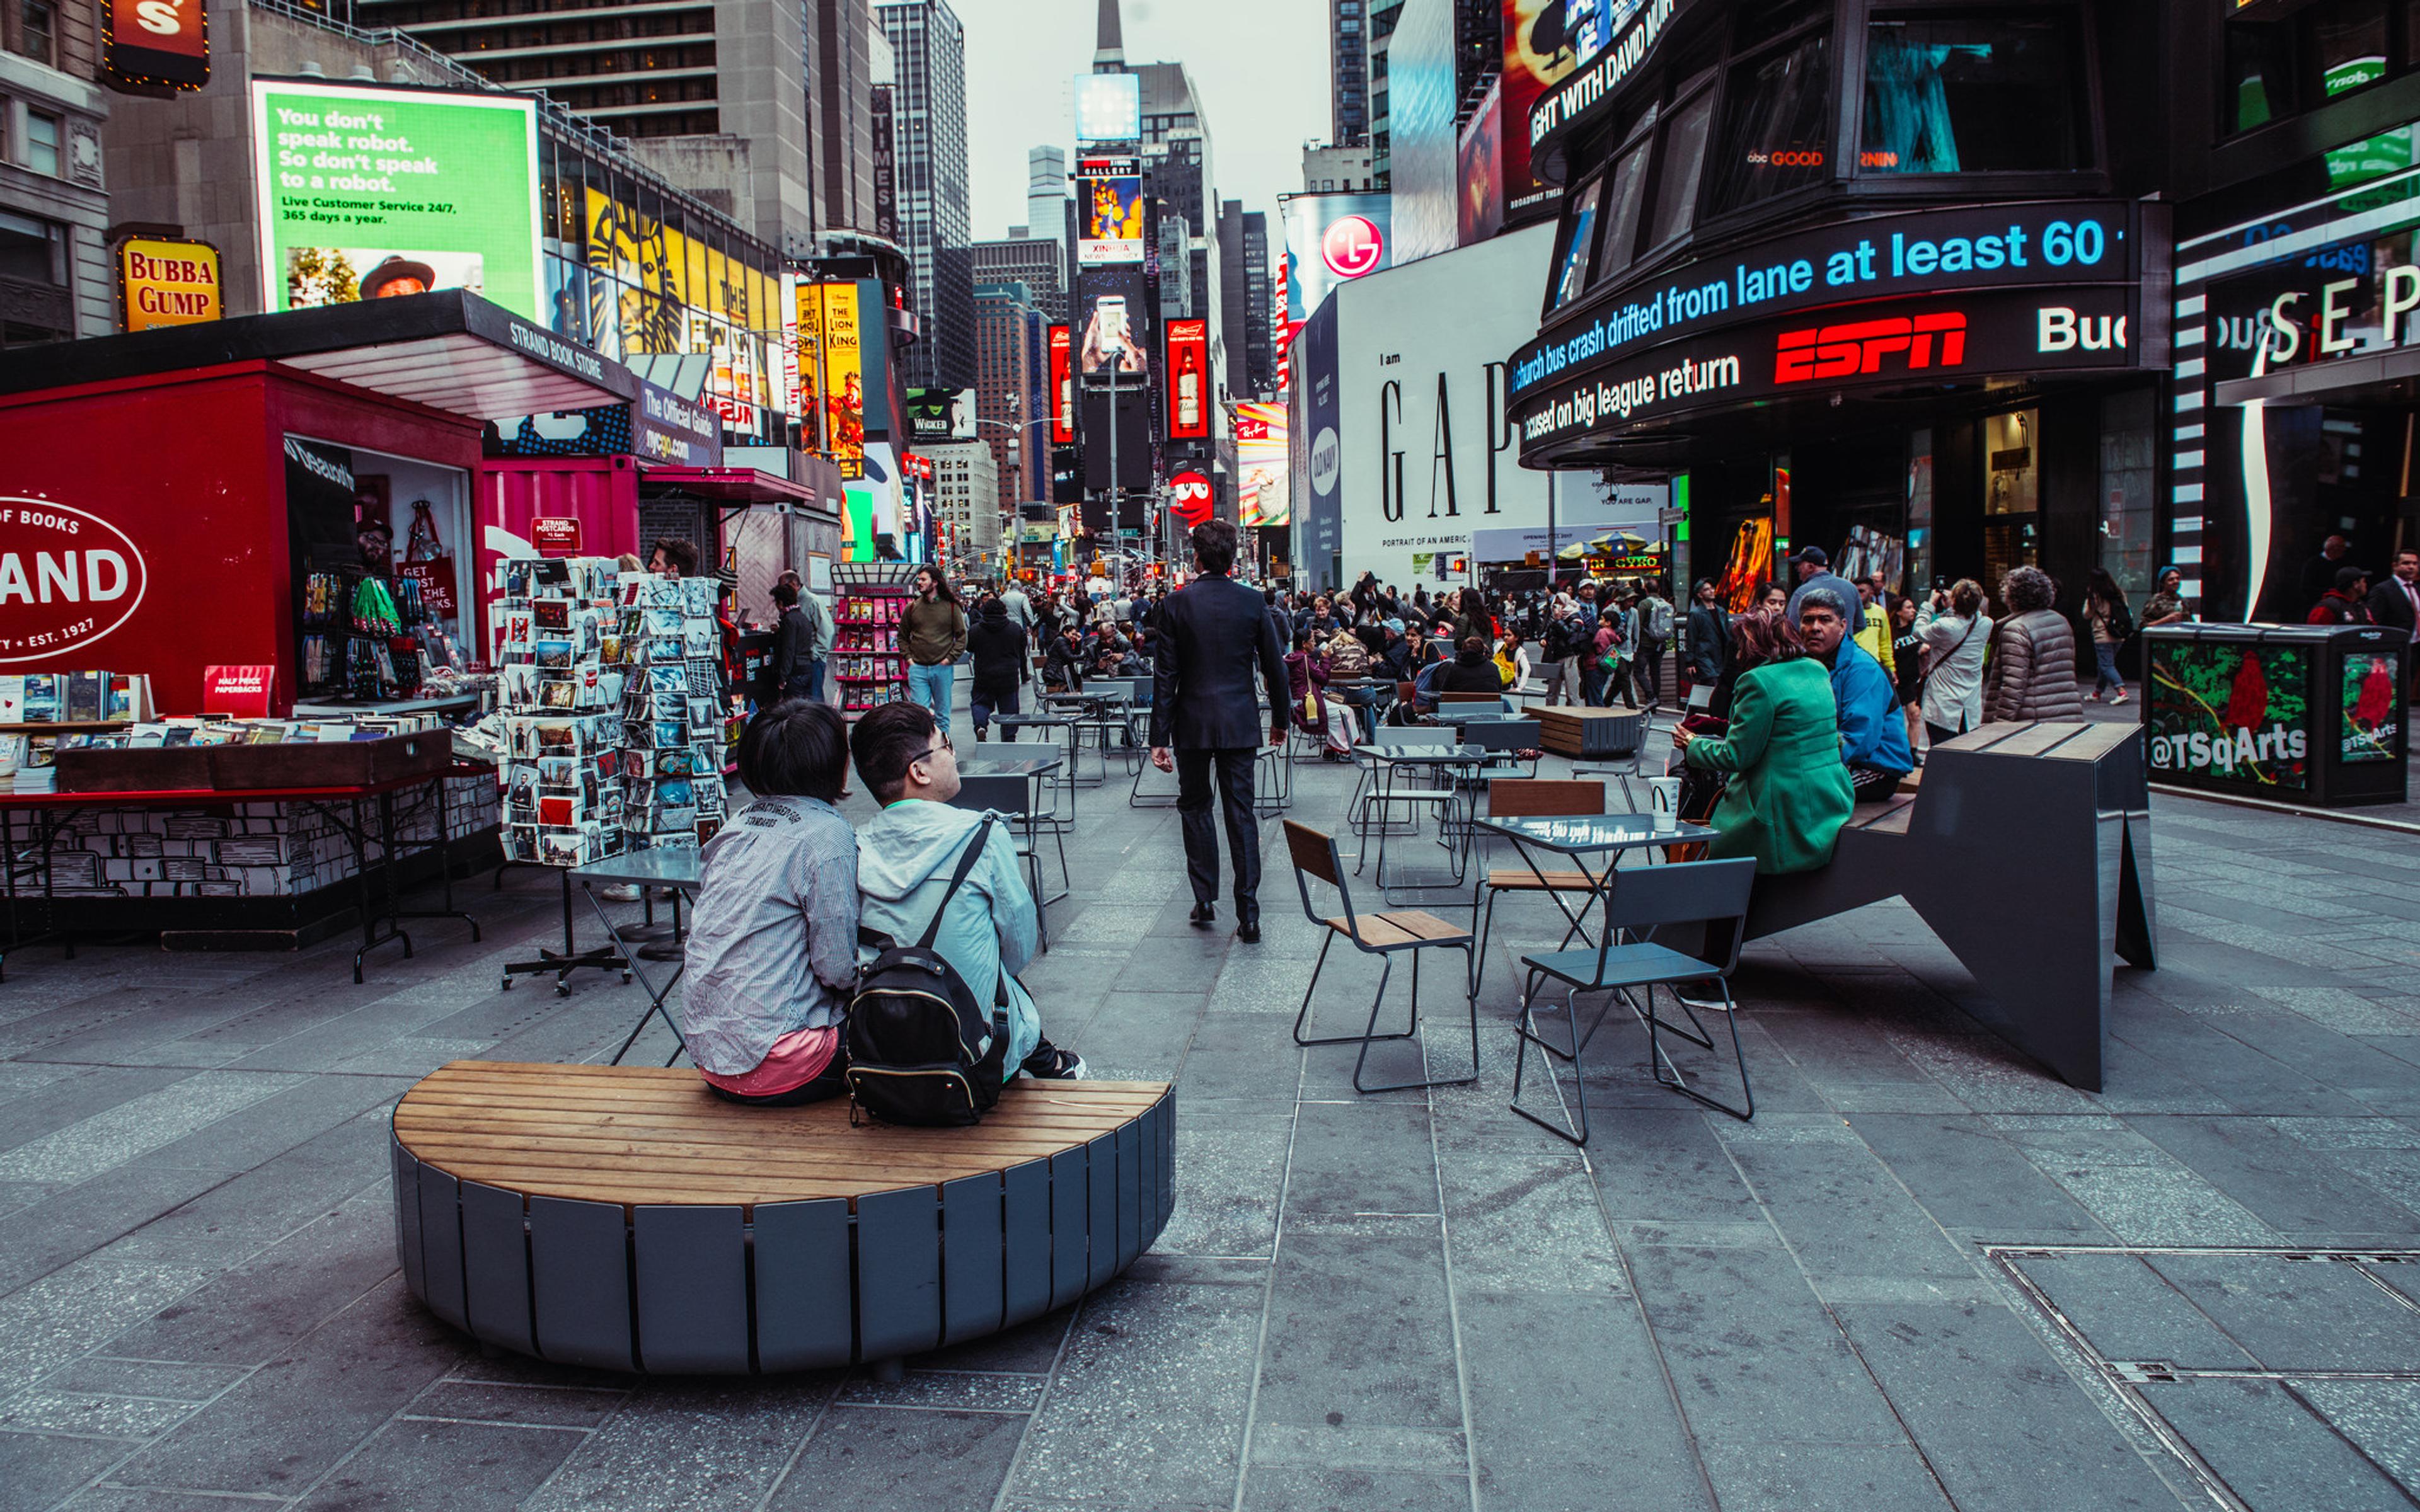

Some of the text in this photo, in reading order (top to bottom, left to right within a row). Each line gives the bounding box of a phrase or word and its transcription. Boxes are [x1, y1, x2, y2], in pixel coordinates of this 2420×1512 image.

[1561, 64, 1603, 120] WITH
[1606, 23, 1645, 90] DAVID
[276, 108, 383, 130] You don't
[277, 131, 414, 152] speak robot.
[279, 150, 439, 176] So don't speak
[872, 113, 890, 205] TIMES
[1747, 151, 1768, 163] abc
[1772, 151, 1823, 166] GOOD
[279, 171, 397, 192] to a robot.
[1084, 166, 1132, 176] GALLERY
[282, 197, 309, 207] Live
[313, 197, 374, 210] Customer
[378, 200, 424, 212] Service
[1510, 193, 1544, 210] BROADWAY
[282, 210, 306, 220] 365
[309, 211, 340, 224] days
[355, 217, 388, 226] year.
[129, 252, 215, 284] BUBBA
[138, 287, 209, 316] GUMP
[1517, 220, 2105, 391] church bus crash drifted from lane at least 60
[830, 319, 853, 331] LION
[510, 322, 603, 381] STRAND BOOK STORE
[829, 333, 857, 349] KING
[1775, 312, 1967, 384] ESPN
[1380, 352, 1400, 366] I am
[1557, 404, 1572, 428] on
[1575, 387, 1595, 427] big
[1598, 375, 1655, 418] league
[1660, 355, 1740, 399] return
[645, 388, 713, 438] The Official Guide
[647, 430, 689, 461] nycgo.com
[1382, 361, 1512, 522] GAP
[1314, 443, 1336, 479] OLD NAVY
[20, 510, 80, 535] BOOKS
[1383, 537, 1415, 547] PORTRAIT
[1416, 537, 1426, 546] OF
[1427, 536, 1438, 545] AN
[404, 566, 427, 576] GET
[28, 632, 59, 647] EST.
[62, 617, 95, 639] 1927
[215, 685, 262, 694] PAPERBACKS
[2151, 723, 2307, 772] @TSqArts
[2341, 723, 2397, 753] @TSqArts
